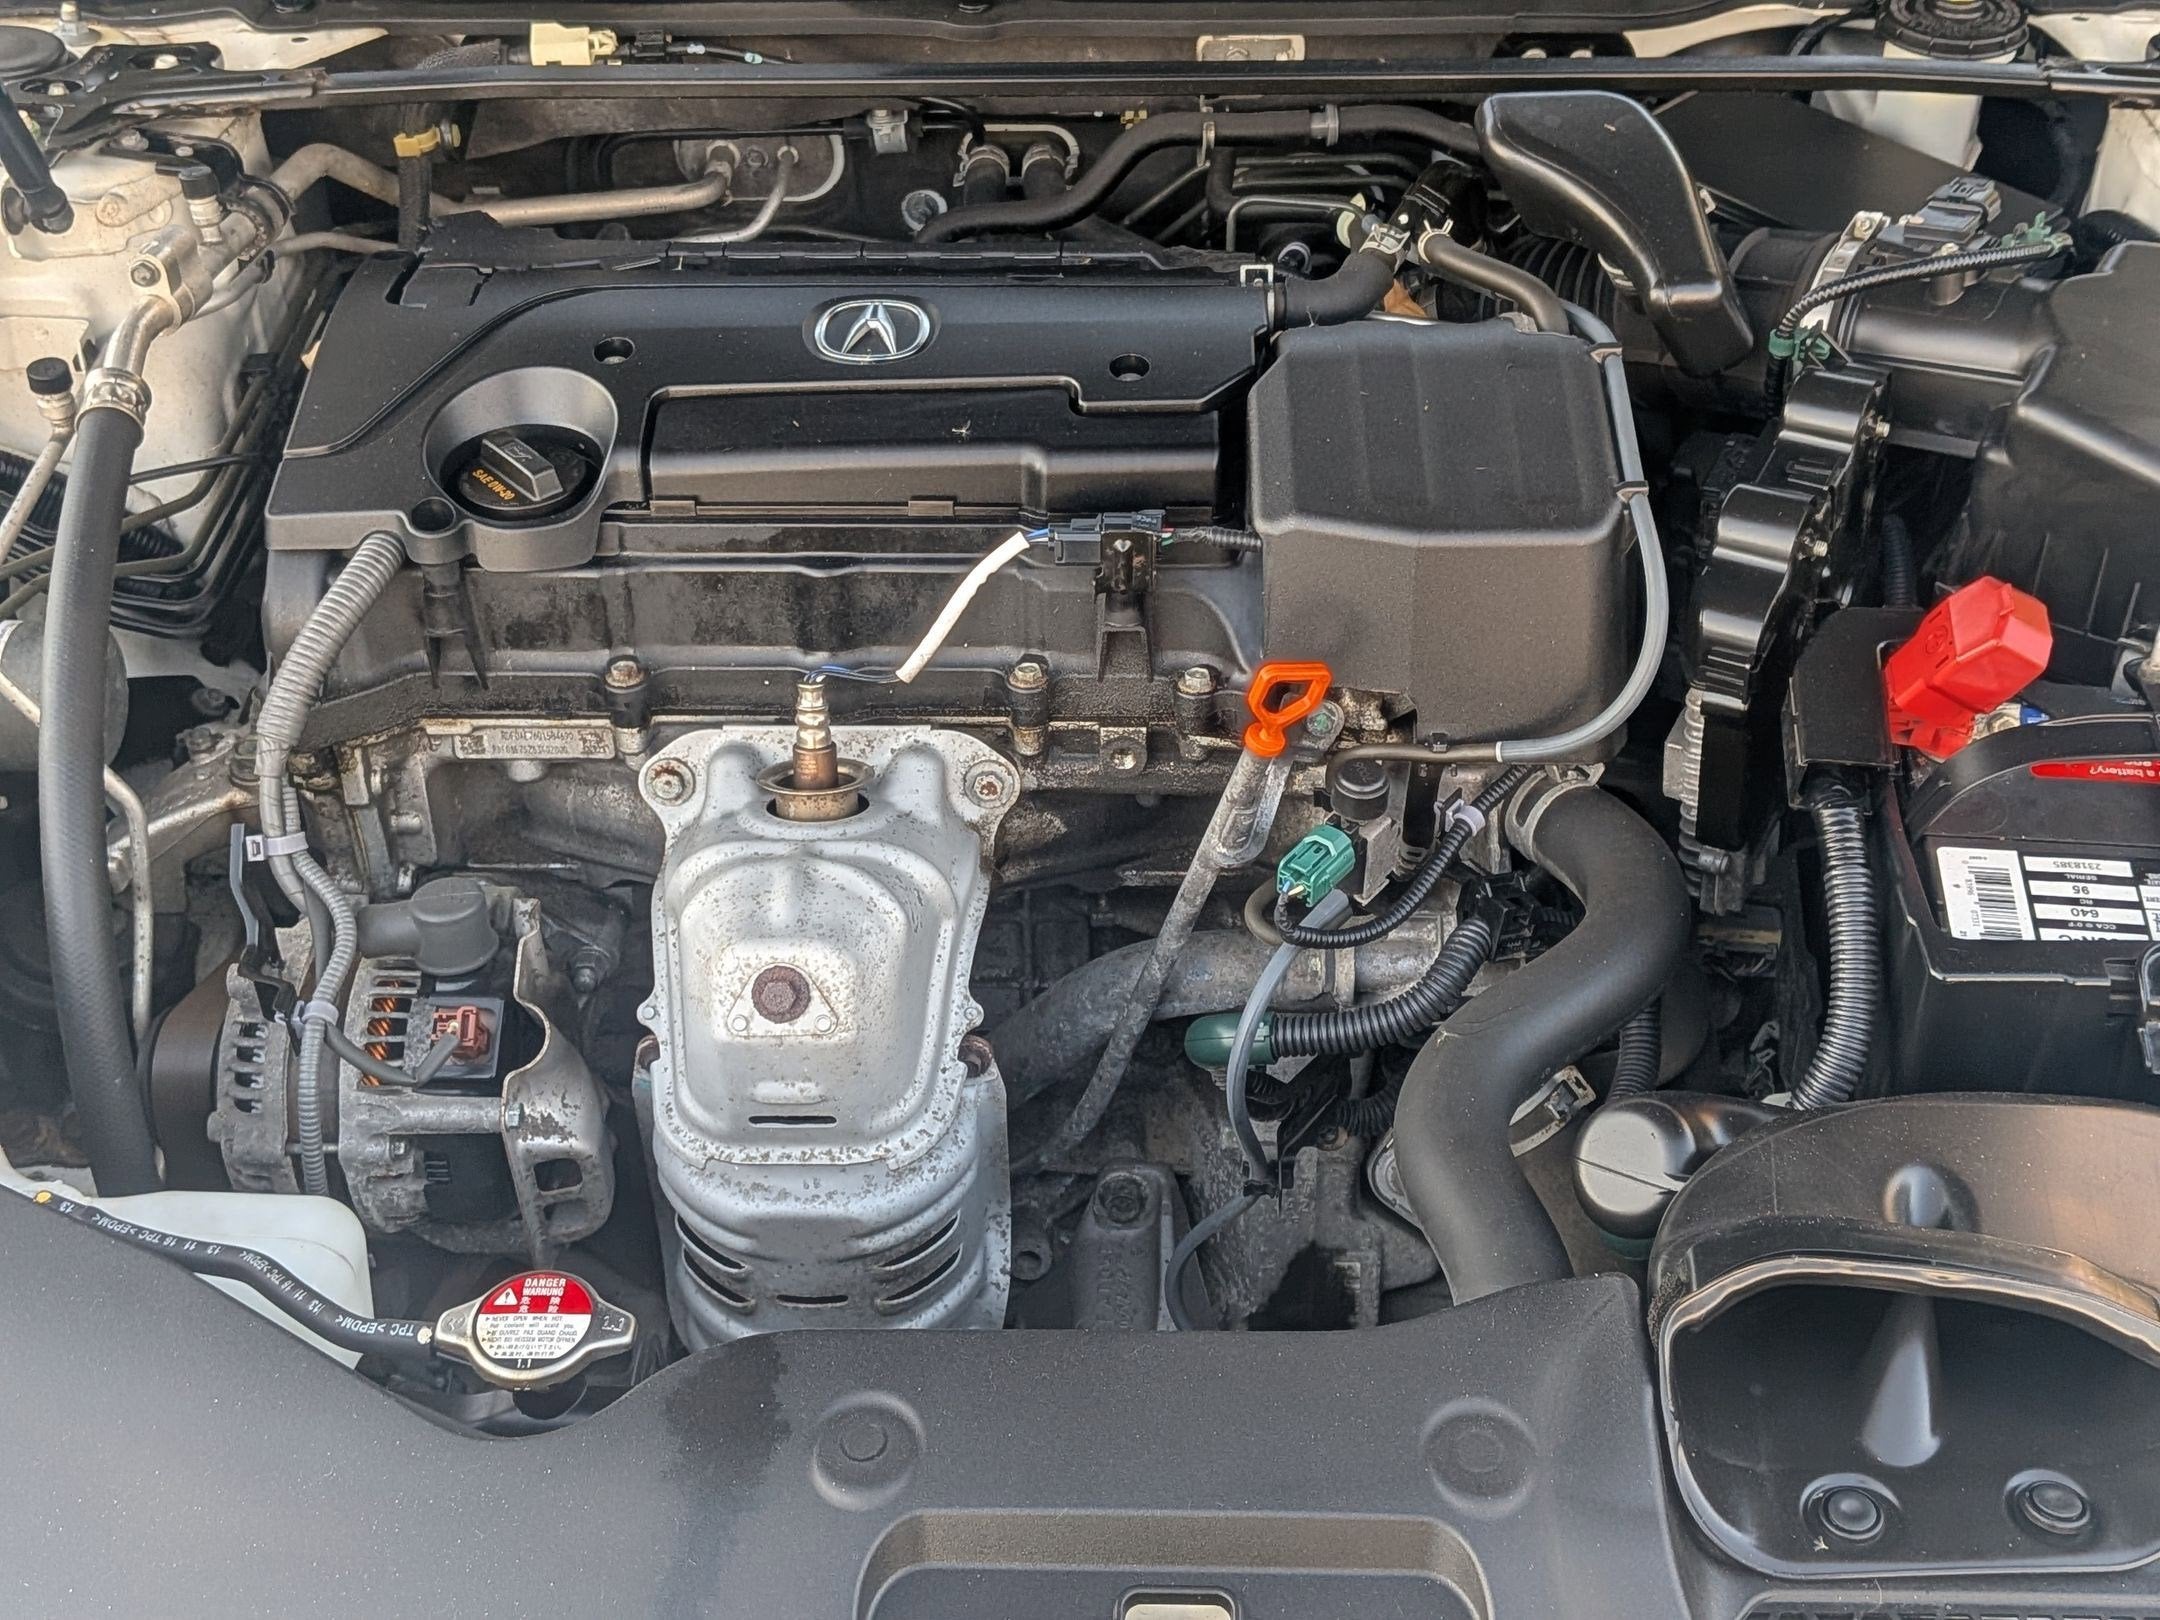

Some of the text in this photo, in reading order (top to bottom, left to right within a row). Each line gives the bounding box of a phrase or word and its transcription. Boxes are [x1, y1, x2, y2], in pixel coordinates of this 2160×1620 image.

[472, 468, 516, 501] SAE 0W-20
[2089, 764, 2144, 778] battery?
[2064, 873, 2098, 881] SERIAL
[2071, 885, 2090, 895] 95
[2070, 907, 2099, 919] 640
[2095, 922, 2117, 930] CCA
[138, 1230, 162, 1244] TPC
[182, 1240, 199, 1251] 11
[205, 1245, 225, 1256] 13
[266, 1269, 287, 1285] TPC
[524, 1278, 567, 1287] DANGER
[522, 1287, 564, 1296] WARNUNG
[334, 1313, 416, 1337] TPC >EPDM<
[516, 1358, 532, 1369] 1.1
